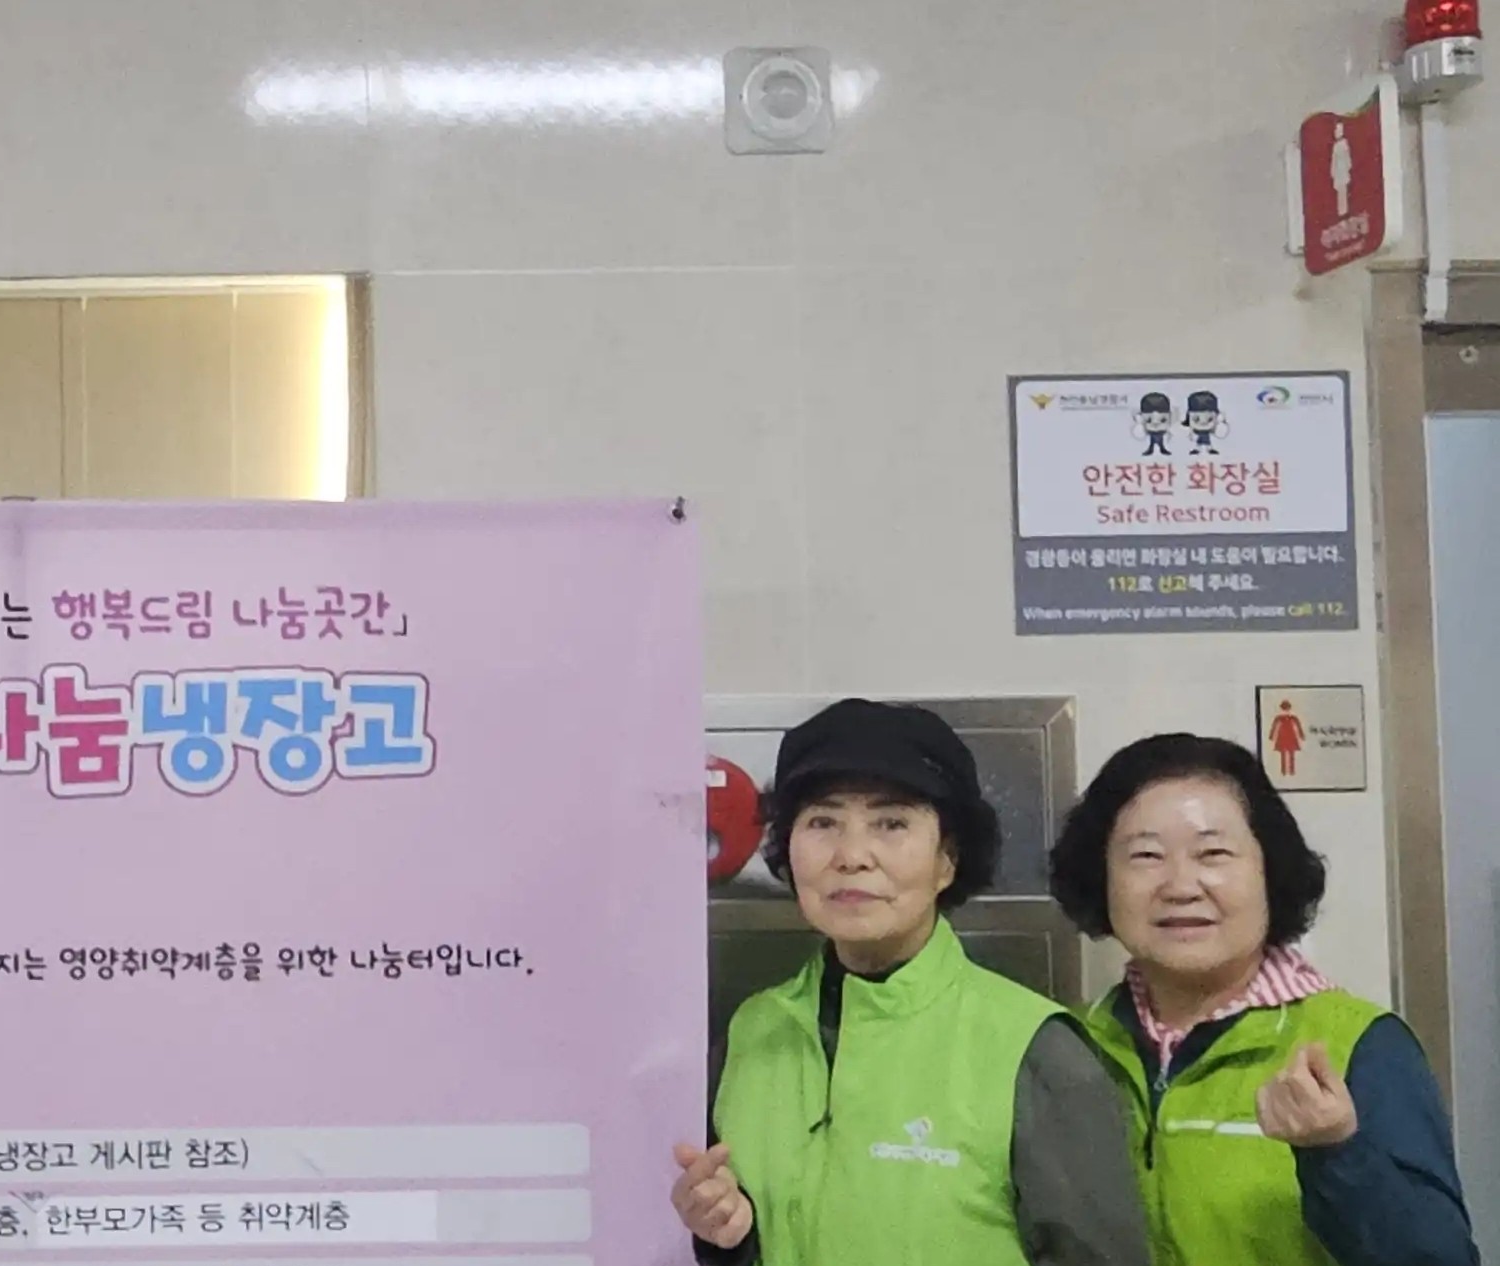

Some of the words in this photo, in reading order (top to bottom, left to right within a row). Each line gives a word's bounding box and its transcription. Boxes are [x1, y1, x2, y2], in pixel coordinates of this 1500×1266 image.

[1082, 462, 1178, 497] 안전한
[1185, 460, 1283, 496] 화장실
[1096, 503, 1150, 525] Safe
[1155, 502, 1271, 523] Restroom
[51, 587, 213, 642] 행복드림
[59, 942, 264, 983] 영양취약계층을
[276, 945, 339, 978] 위한
[349, 941, 535, 979] 나눔터입니다.
[89, 1139, 173, 1170] 게시판
[184, 1138, 251, 1171] 참조)
[46, 1203, 187, 1236] 한부모가족
[197, 1202, 227, 1232] 등
[238, 1200, 351, 1233] 취약계층
